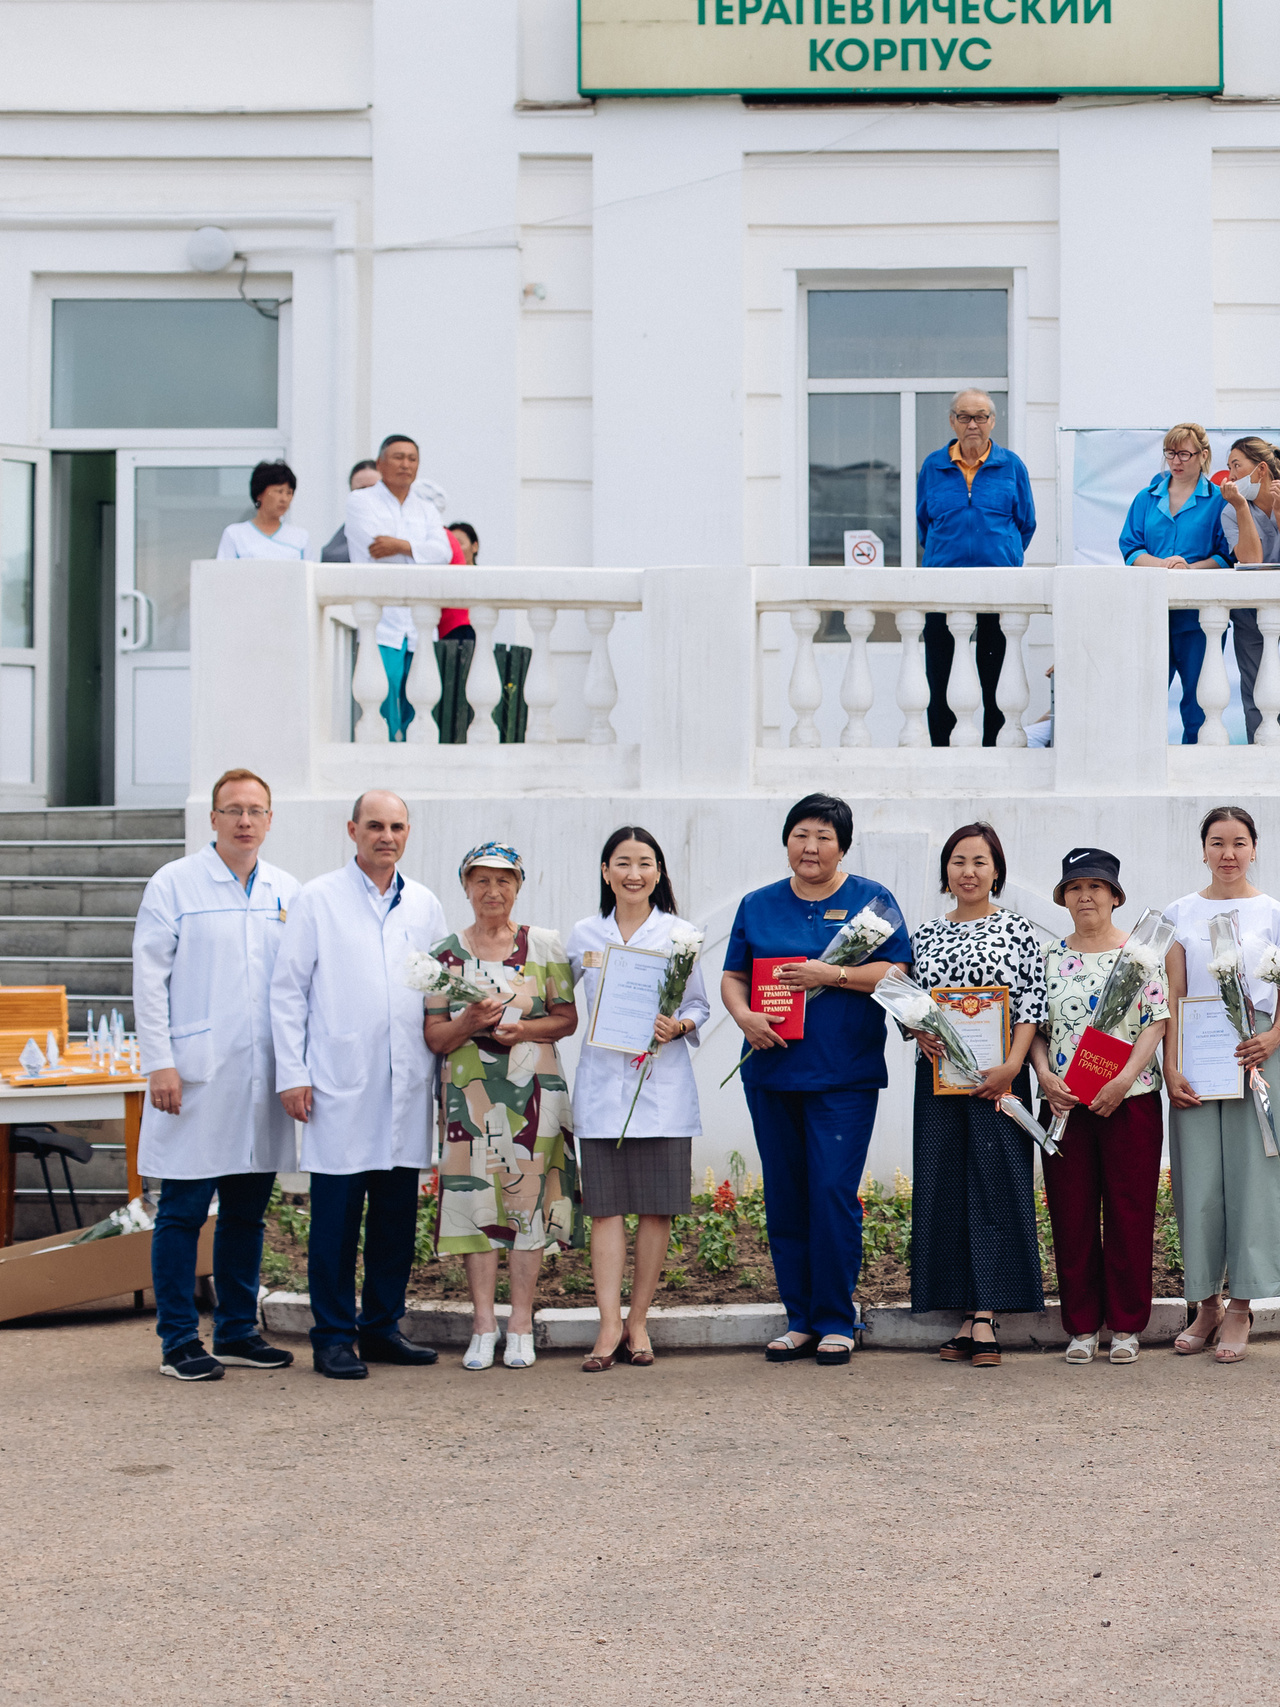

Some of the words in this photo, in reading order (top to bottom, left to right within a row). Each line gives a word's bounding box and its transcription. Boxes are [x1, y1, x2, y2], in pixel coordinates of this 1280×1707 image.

[809, 37, 992, 72] КОРПУС
[761, 998, 794, 1006] ПОЧЕТНАЯ
[1078, 1058, 1113, 1079] ГРАМОТА
[1080, 1048, 1119, 1072] ПОЧЕТНАЯ
